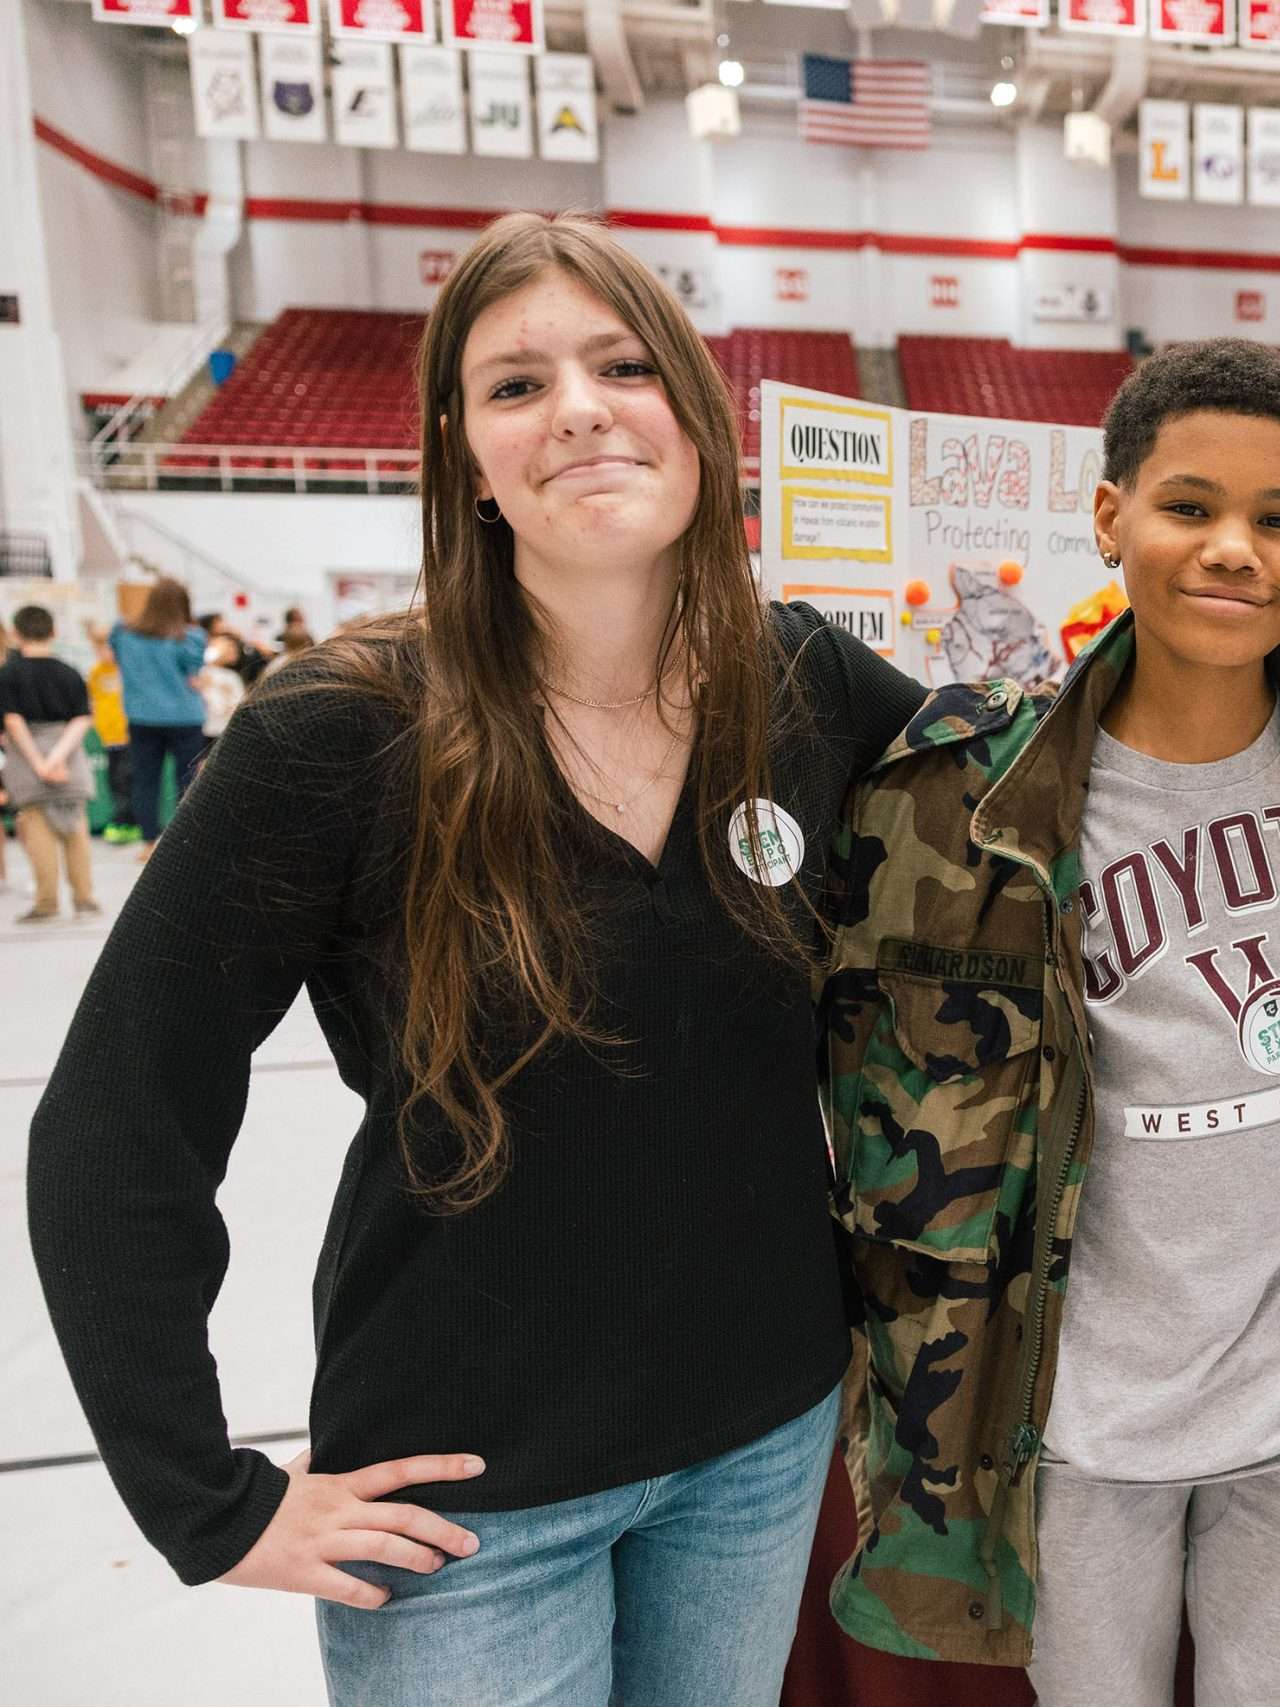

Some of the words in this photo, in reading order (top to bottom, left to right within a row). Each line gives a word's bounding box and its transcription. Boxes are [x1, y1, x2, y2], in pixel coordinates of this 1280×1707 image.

[791, 423, 881, 465] QUESTION
[910, 418, 1032, 511] Lava
[925, 510, 1030, 567] Protecting
[1142, 1103, 1246, 1134] WEST
